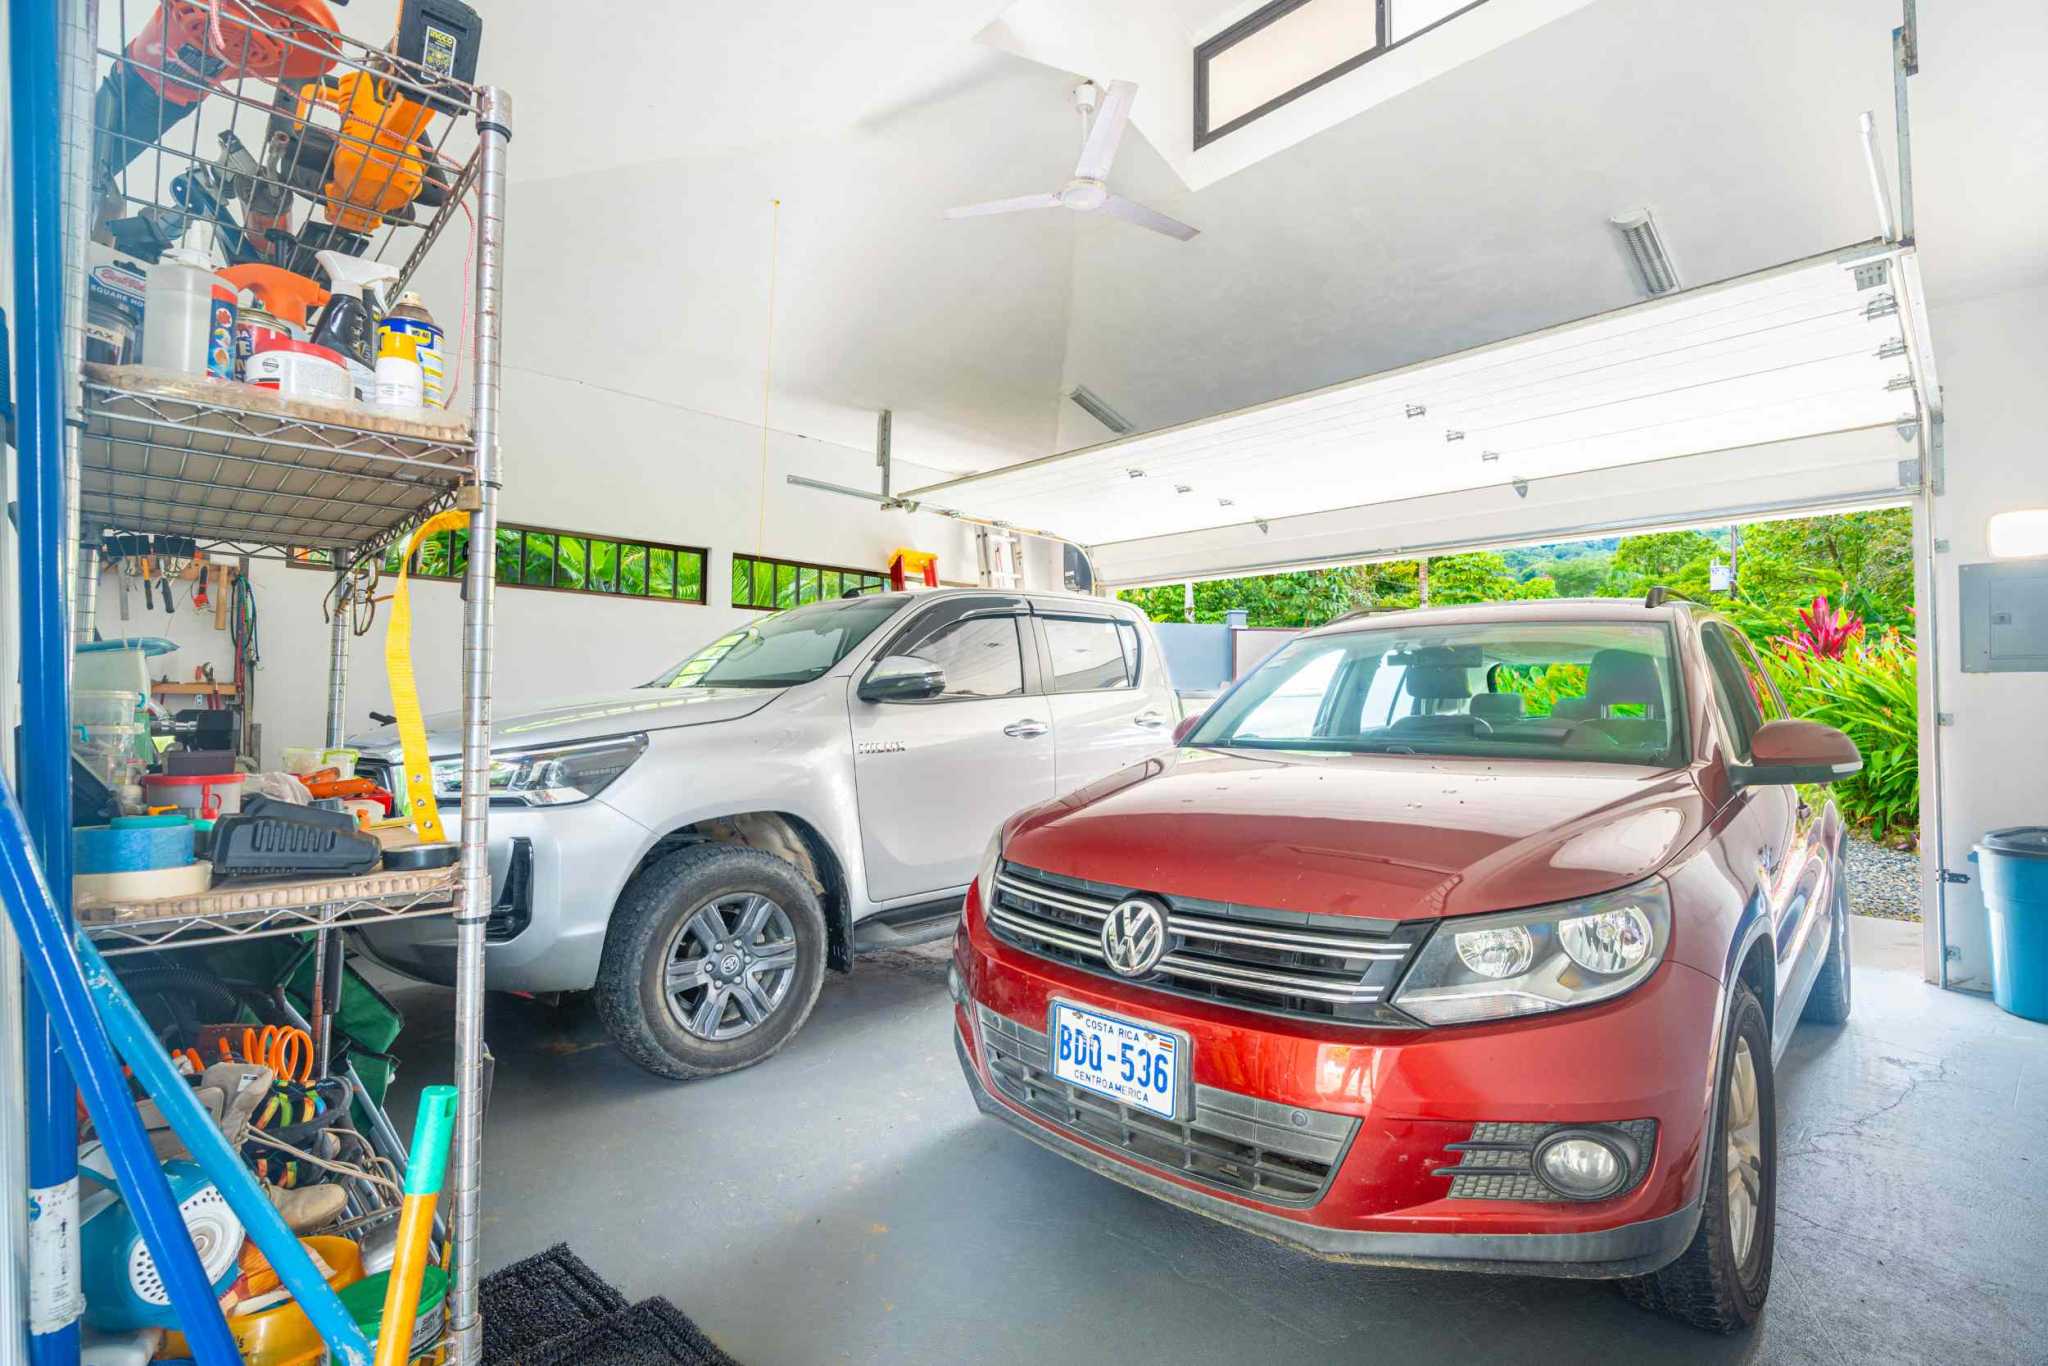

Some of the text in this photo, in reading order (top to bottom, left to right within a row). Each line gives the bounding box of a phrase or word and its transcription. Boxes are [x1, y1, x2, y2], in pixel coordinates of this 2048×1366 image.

[859, 741, 906, 754] HILUX
[1085, 1018, 1140, 1042] COSTA RICA
[1059, 1023, 1169, 1095] BDQ-536
[1074, 1069, 1149, 1103] CENTROAMERICA
